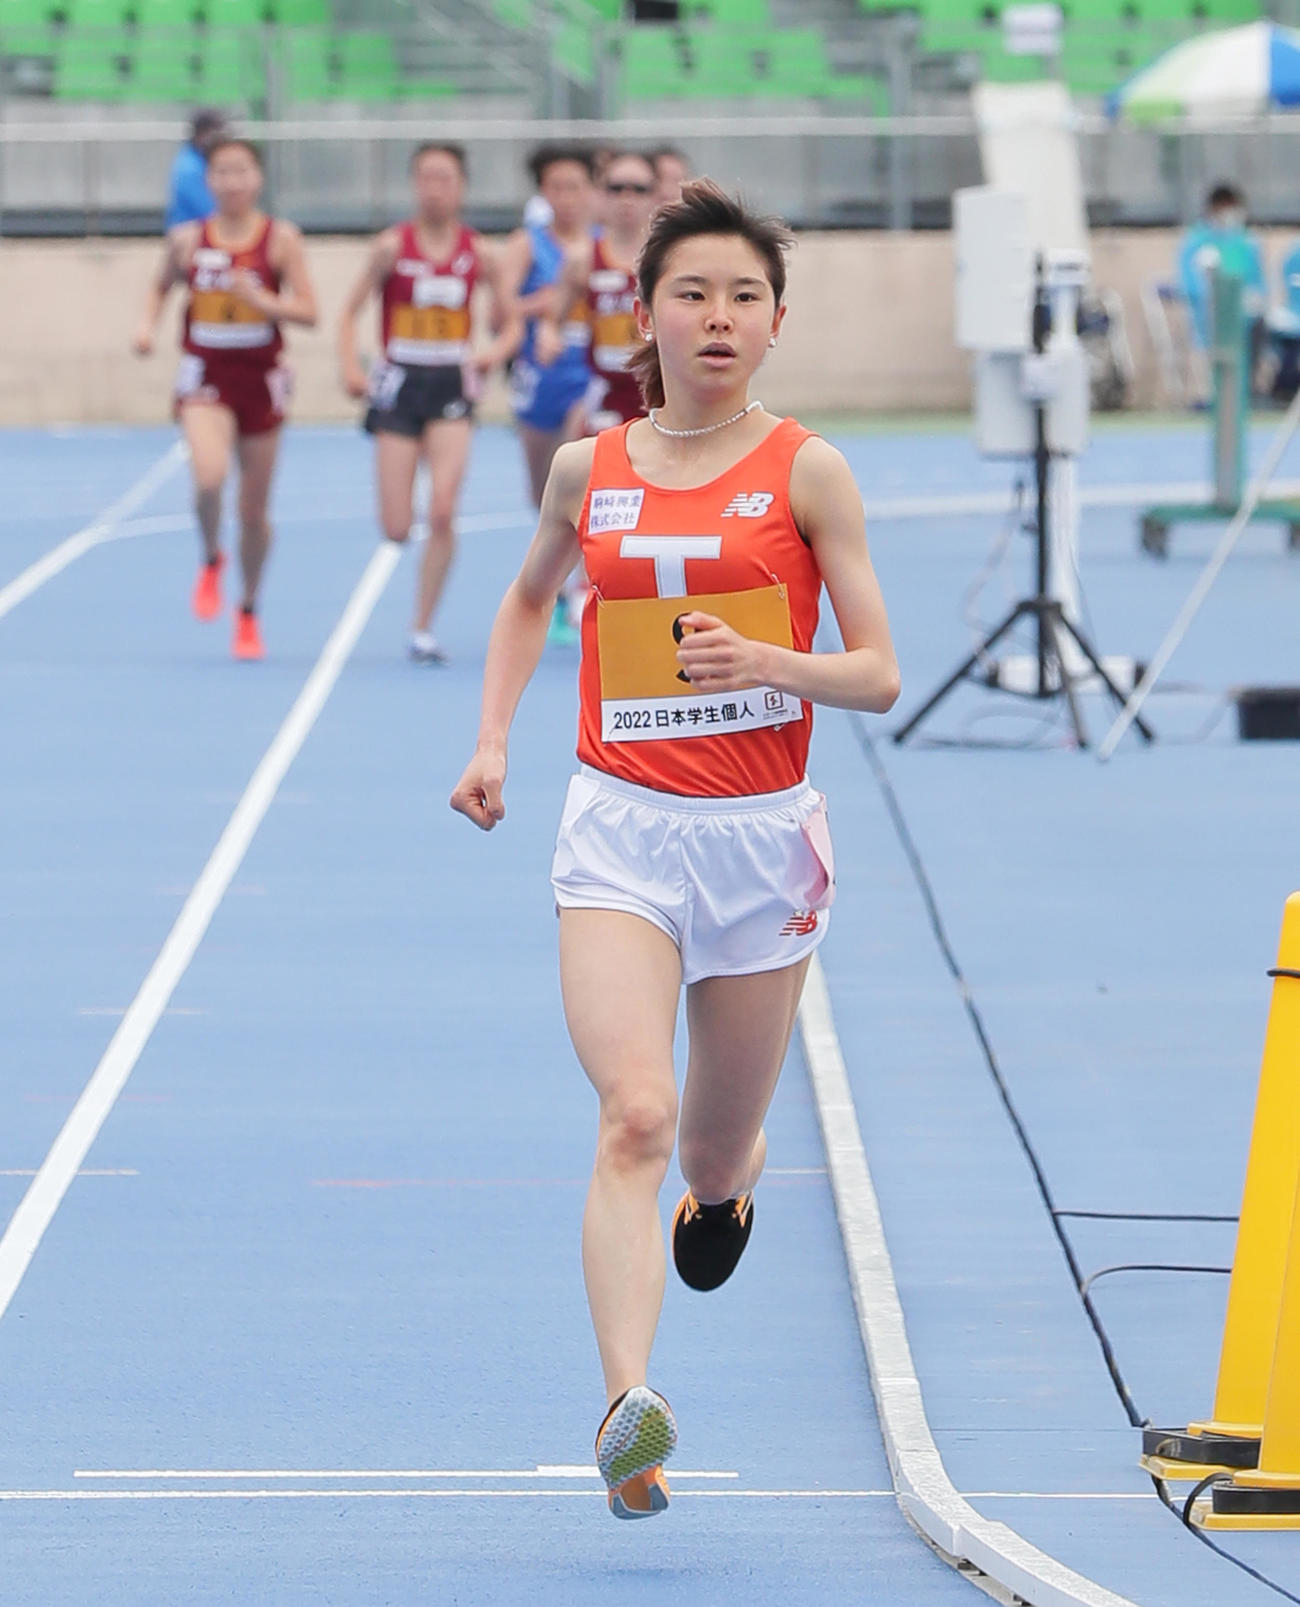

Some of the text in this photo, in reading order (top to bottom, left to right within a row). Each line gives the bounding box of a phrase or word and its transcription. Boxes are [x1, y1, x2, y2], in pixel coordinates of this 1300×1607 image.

[590, 512, 635, 528] 株式会社
[619, 535, 722, 599] T
